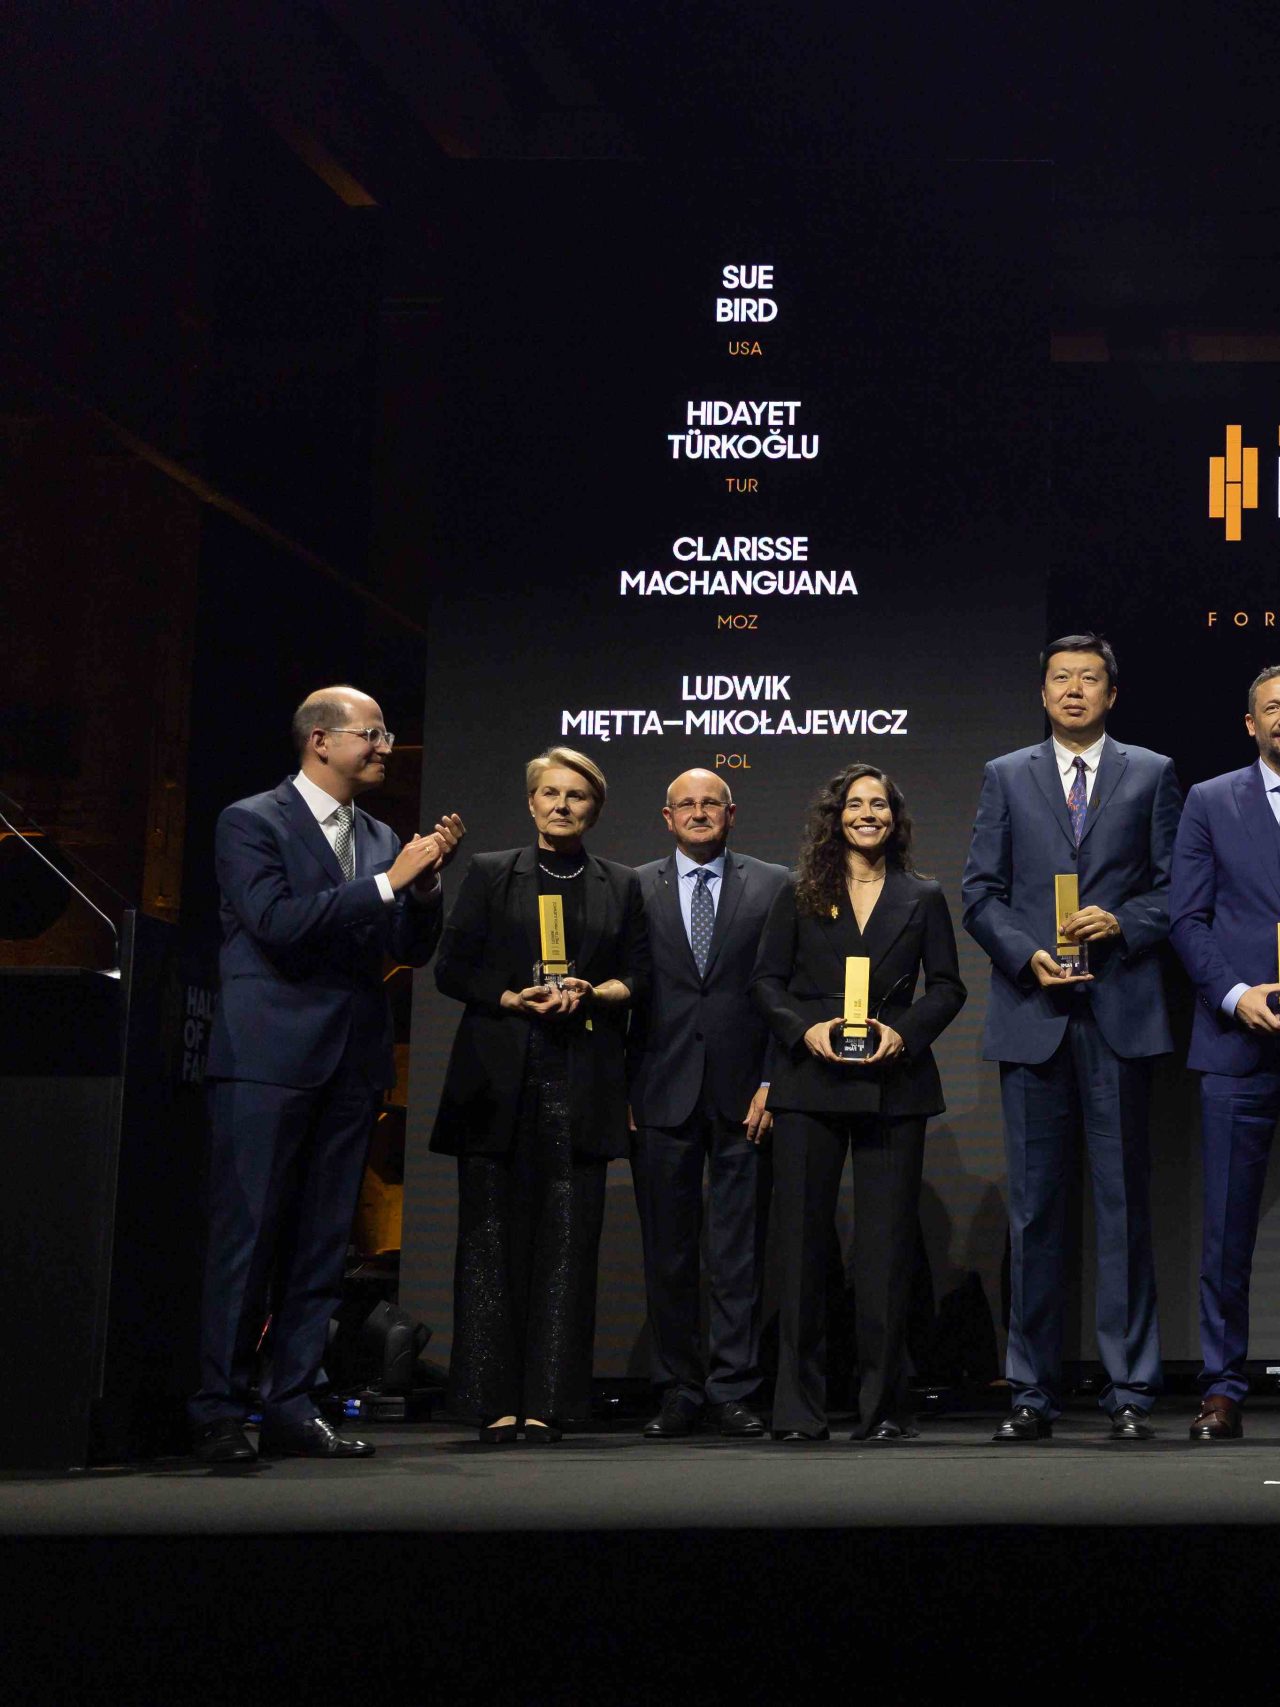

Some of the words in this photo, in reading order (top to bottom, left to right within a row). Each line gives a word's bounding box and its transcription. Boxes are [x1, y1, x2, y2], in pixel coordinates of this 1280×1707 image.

[723, 265, 773, 289] SUE
[716, 298, 778, 322] BIRD
[729, 342, 762, 355] USA
[687, 401, 801, 425] HIDAYET
[668, 429, 819, 459] TÜRKOĞLU
[726, 479, 758, 492] TUR
[673, 537, 808, 561] CLARISSE
[620, 570, 858, 595] MACHANGUANA
[718, 615, 758, 629] MOZ
[1209, 612, 1275, 626] FOR
[682, 675, 791, 700] LUDWIK
[716, 754, 751, 768] POL
[184, 1018, 204, 1050] OF
